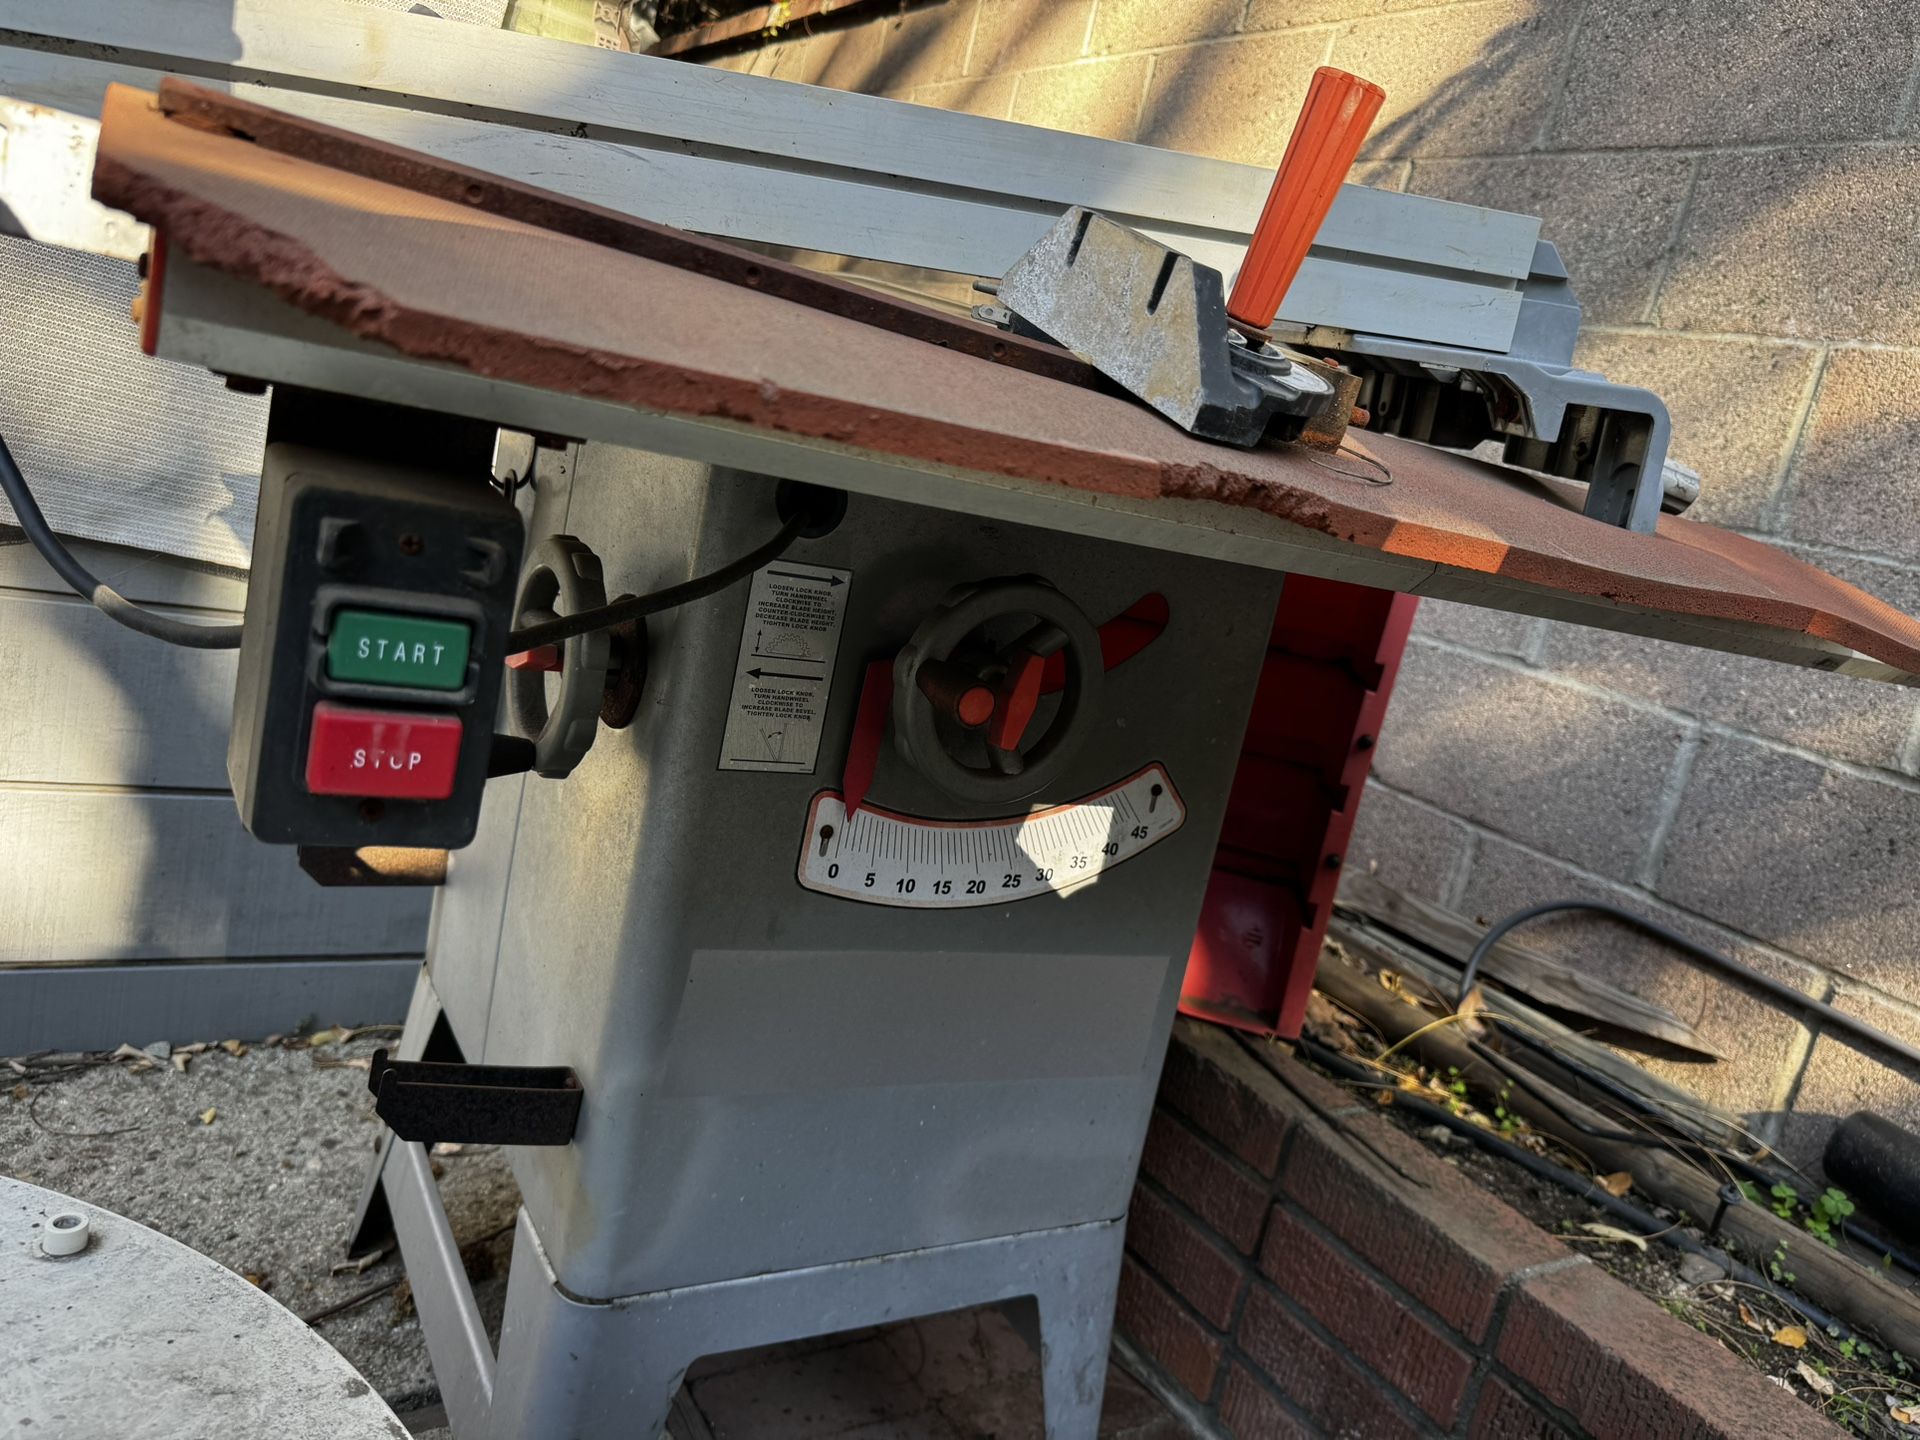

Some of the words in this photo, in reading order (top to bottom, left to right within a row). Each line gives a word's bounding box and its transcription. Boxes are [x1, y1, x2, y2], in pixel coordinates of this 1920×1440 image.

[357, 637, 444, 666] START
[828, 864, 839, 878] 0
[864, 872, 876, 887] 5
[896, 878, 916, 893] 10
[932, 880, 952, 894] 15
[966, 880, 986, 894] 20
[1002, 874, 1022, 888] 25
[1035, 868, 1054, 882] 30
[1070, 856, 1088, 869] 35
[1101, 843, 1119, 856] 40
[1131, 826, 1148, 839] 45
